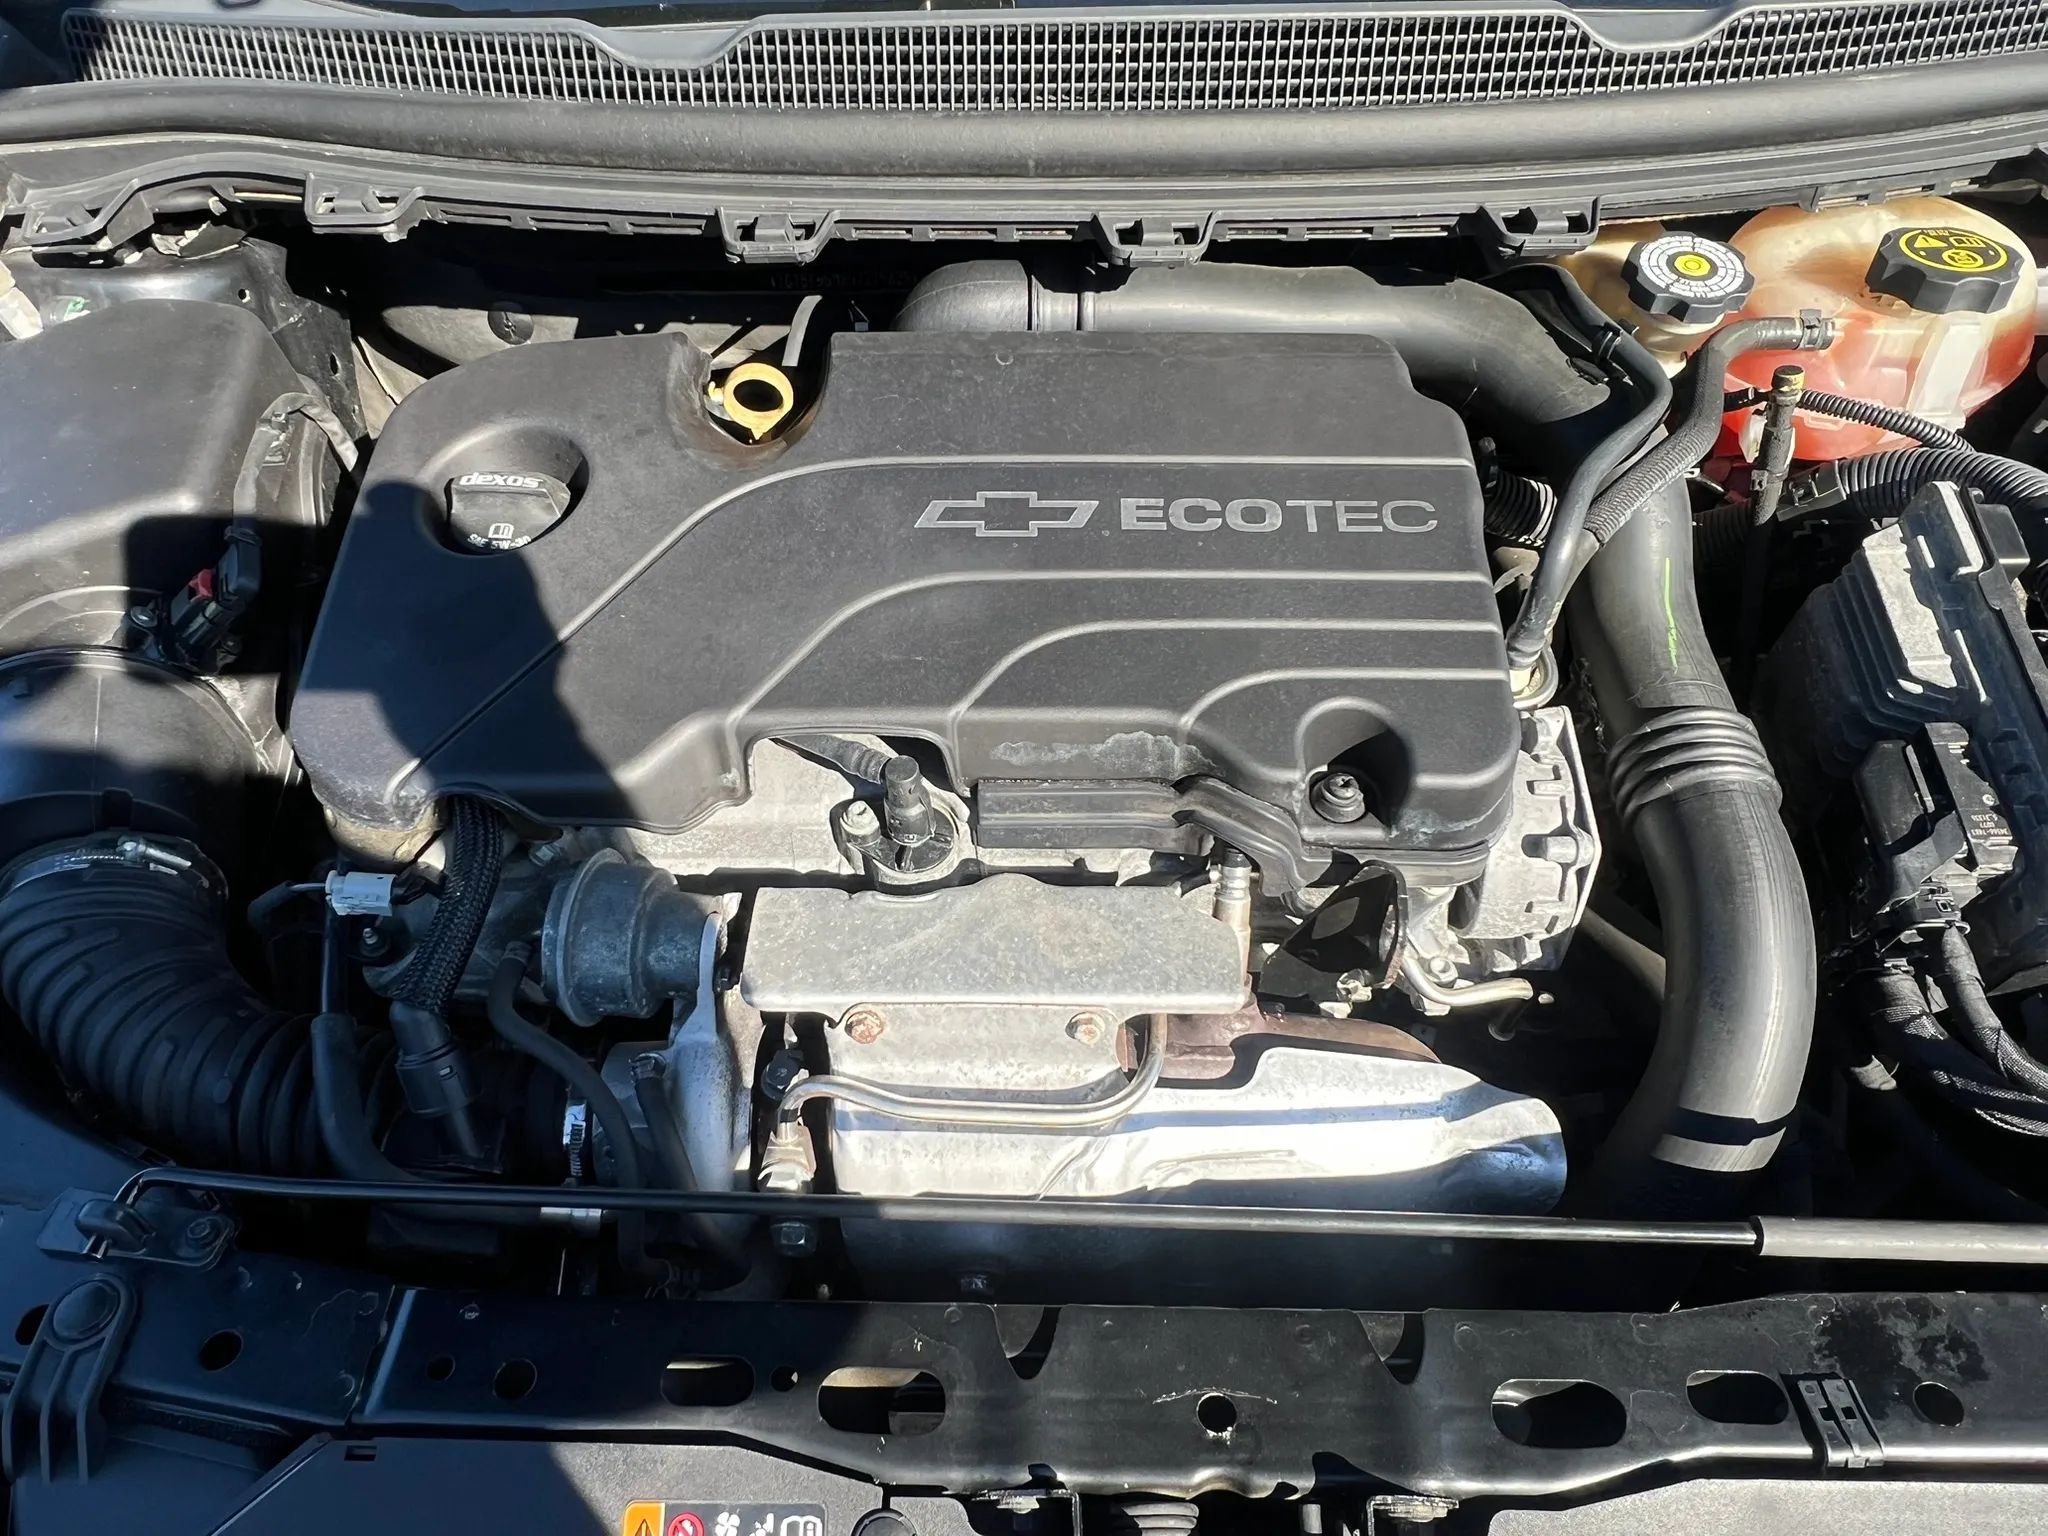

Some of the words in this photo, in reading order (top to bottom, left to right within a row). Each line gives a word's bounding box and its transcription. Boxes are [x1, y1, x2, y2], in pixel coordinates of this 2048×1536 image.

[459, 472, 543, 488] dexos
[1120, 498, 1438, 532] ECOTEC
[467, 533, 489, 548] SAE
